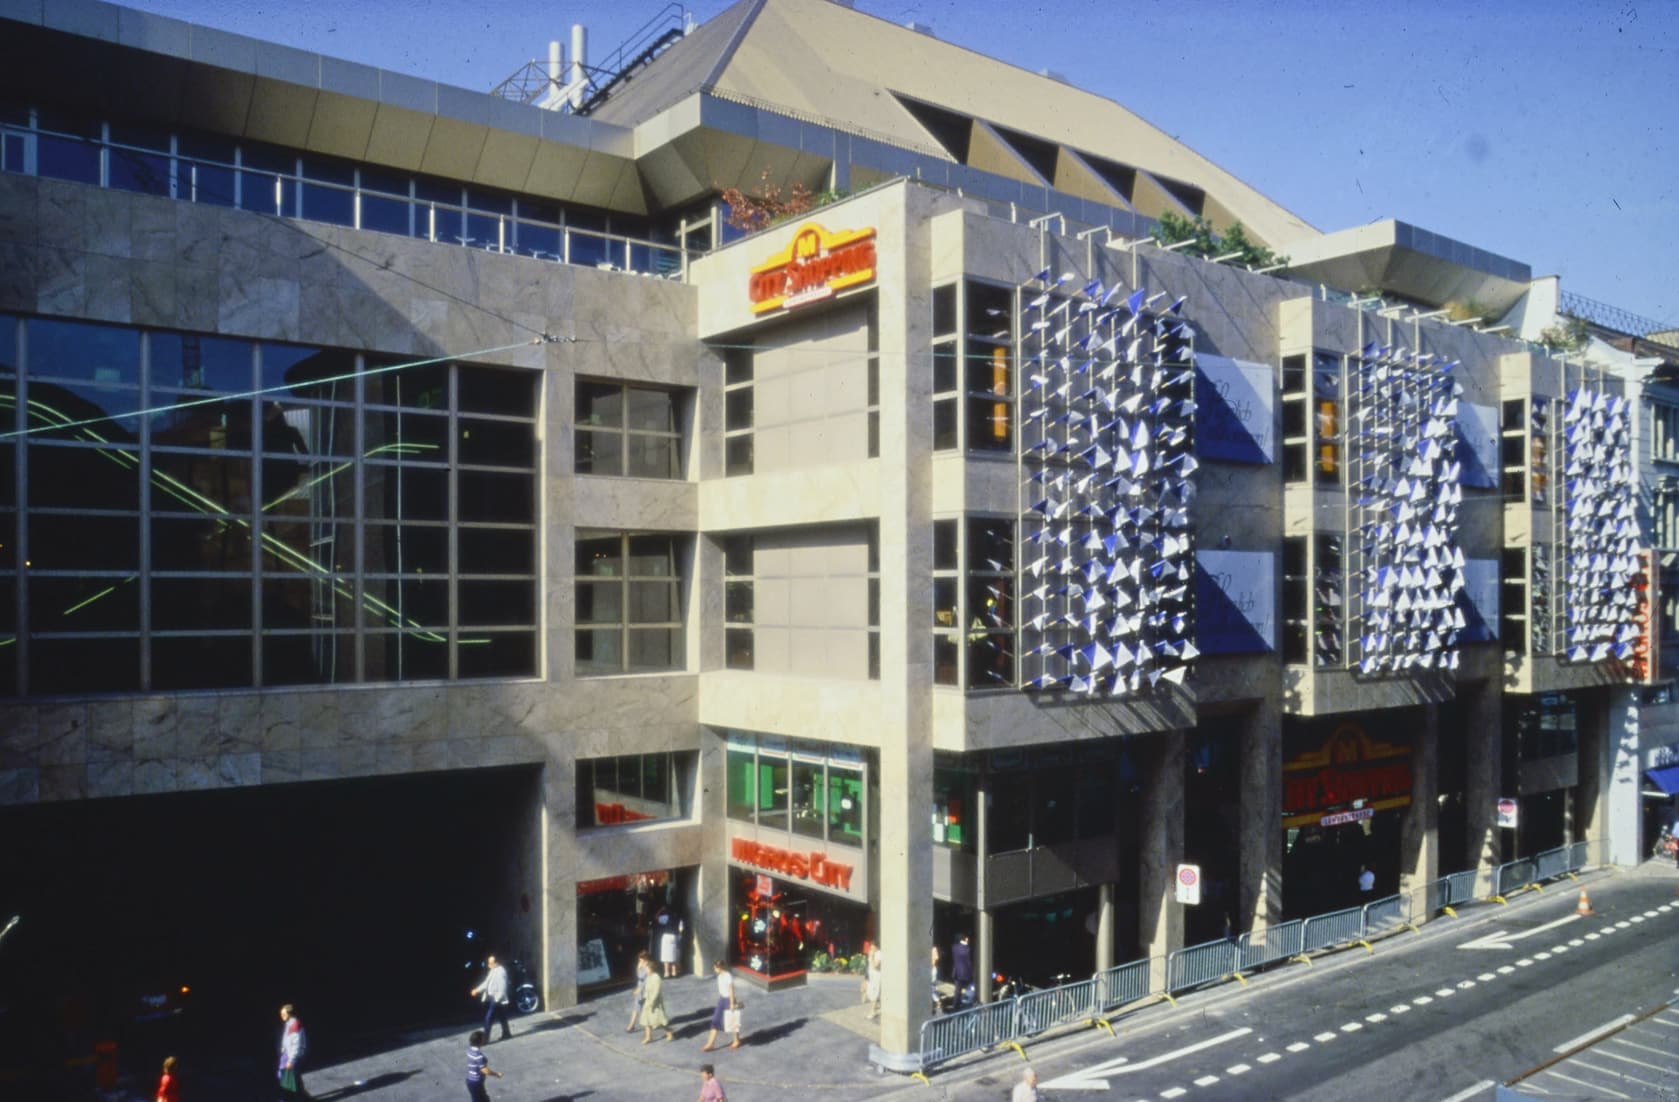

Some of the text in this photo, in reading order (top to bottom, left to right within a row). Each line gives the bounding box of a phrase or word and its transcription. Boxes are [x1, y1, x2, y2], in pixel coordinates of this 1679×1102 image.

[749, 269, 787, 303] CITY
[786, 241, 877, 295] SHOPPING
[797, 233, 816, 257] M
[731, 837, 854, 892] MIGROS CITY
